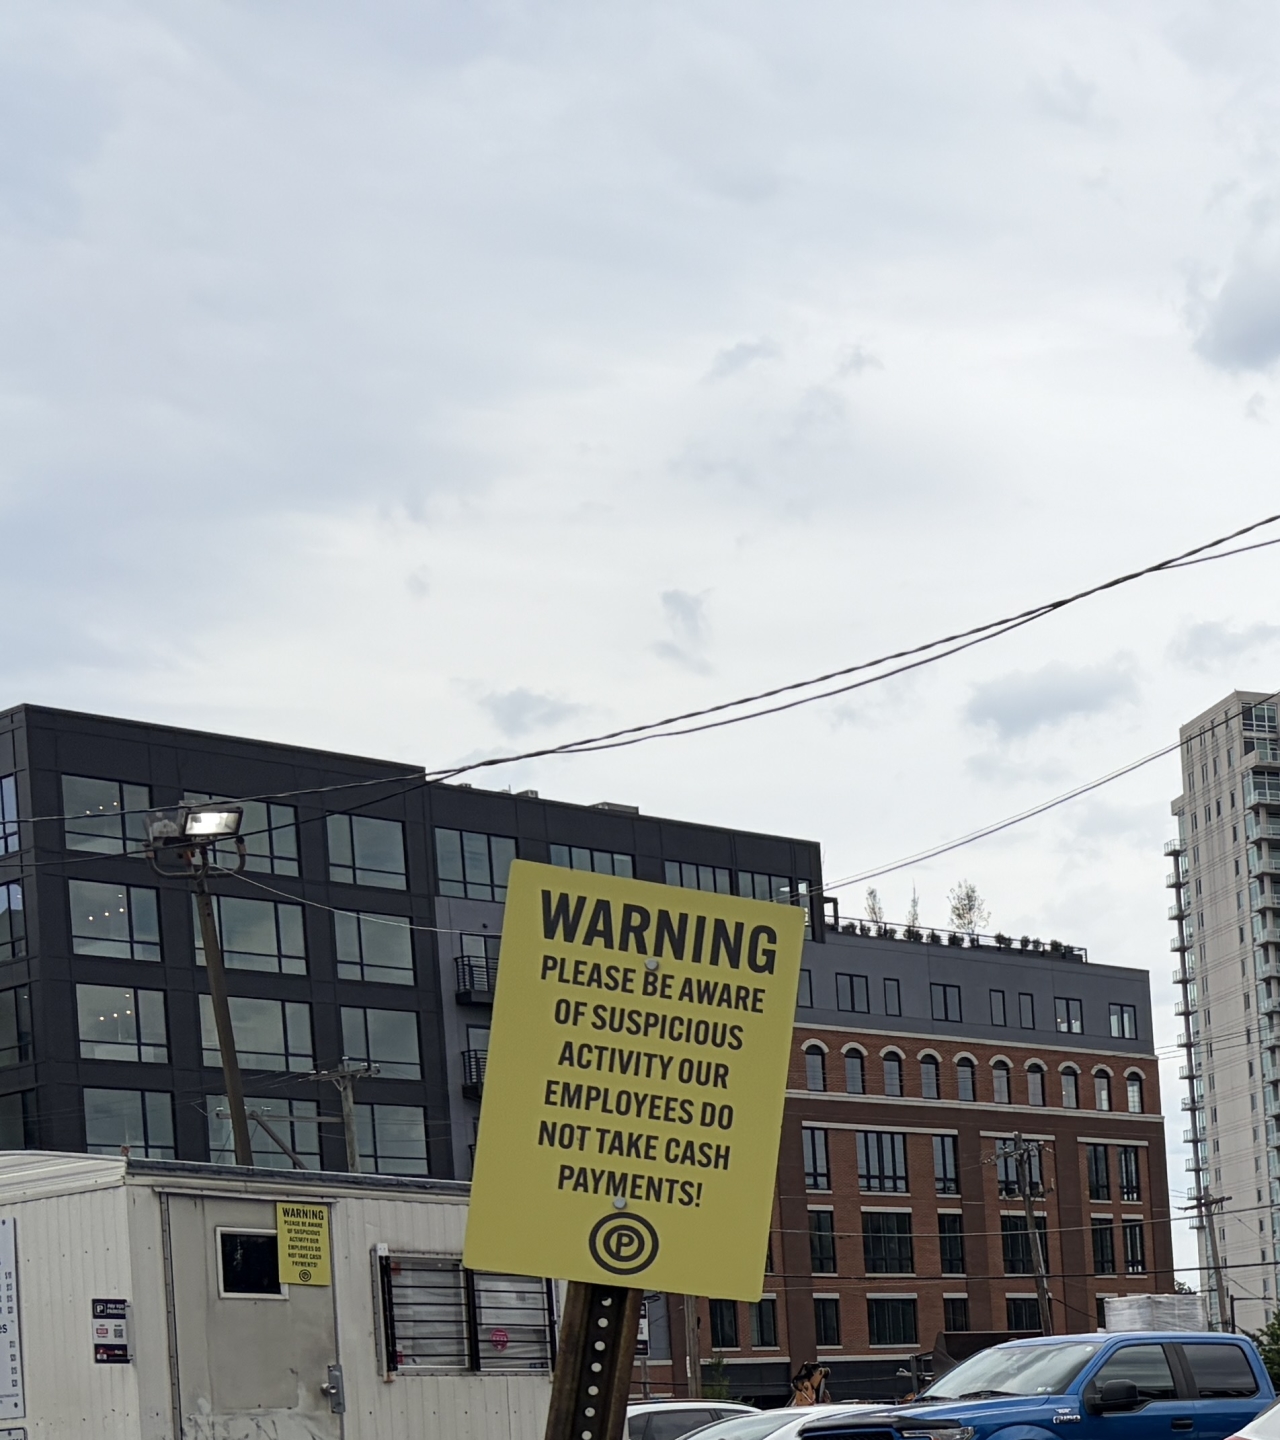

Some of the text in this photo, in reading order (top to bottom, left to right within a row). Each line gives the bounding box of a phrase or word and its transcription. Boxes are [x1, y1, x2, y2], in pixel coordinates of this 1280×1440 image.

[541, 889, 777, 974] WARNING
[540, 955, 765, 1013] PLEASE BE AWARE
[554, 998, 743, 1050] OF SUSPICIOUS
[558, 1041, 729, 1089] ACTIVITY OUR
[544, 1080, 733, 1130] EMPLOYEES DO
[538, 1120, 730, 1170] NOT TAKE CASH
[558, 1165, 702, 1207] PAYMENTS!
[282, 1207, 324, 1220] WARNING
